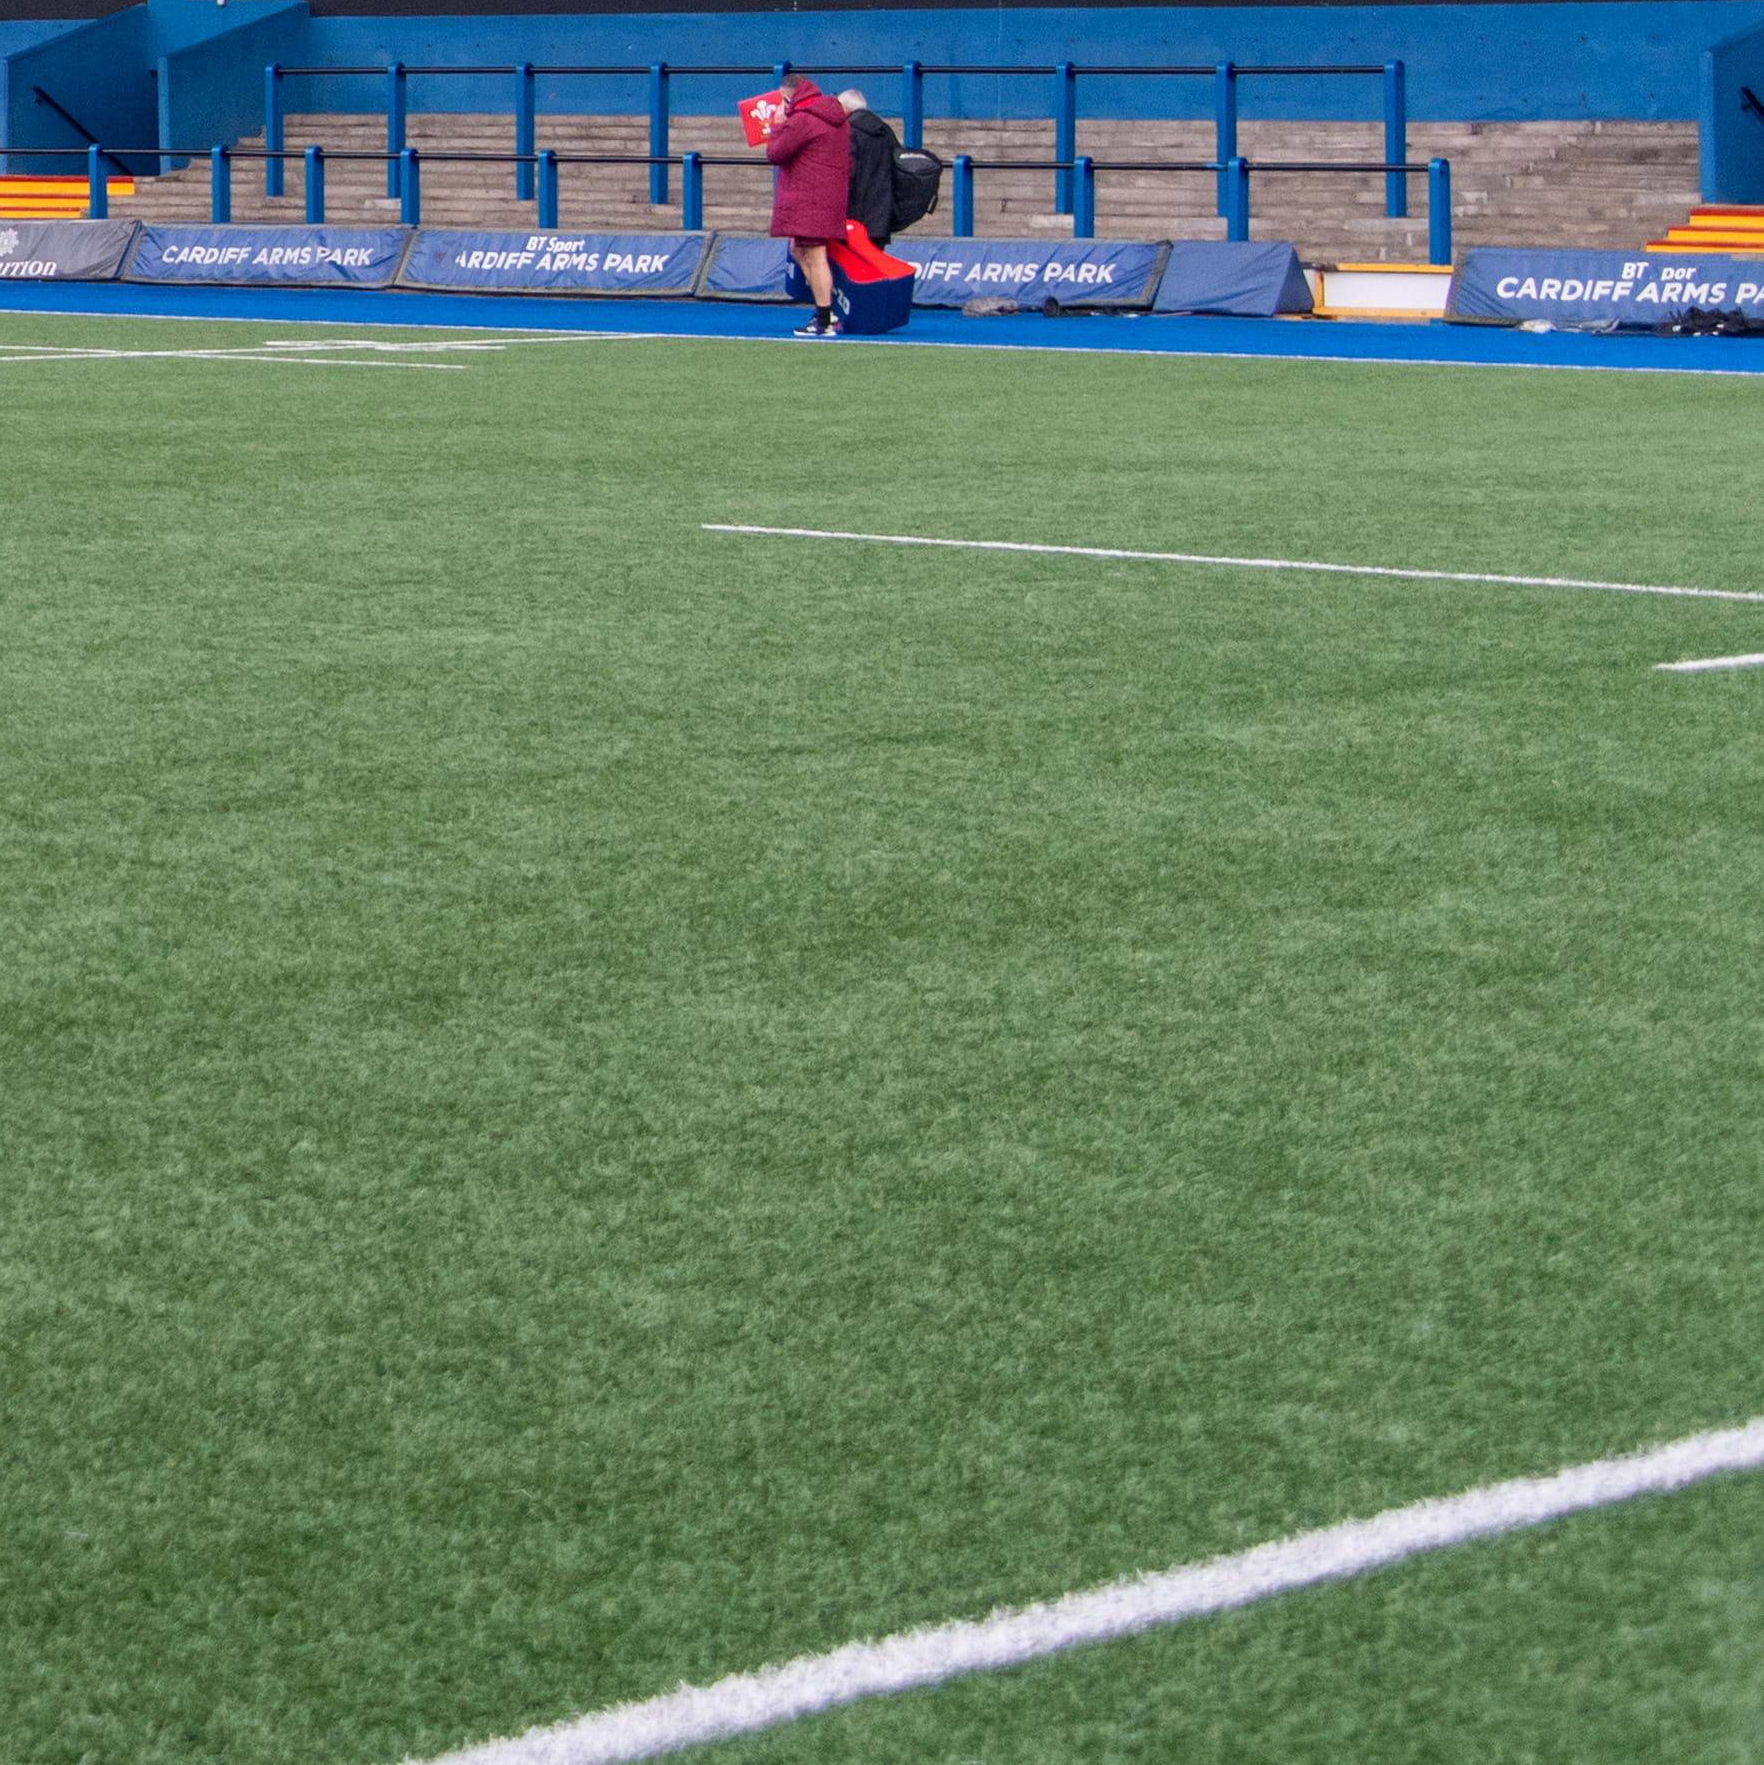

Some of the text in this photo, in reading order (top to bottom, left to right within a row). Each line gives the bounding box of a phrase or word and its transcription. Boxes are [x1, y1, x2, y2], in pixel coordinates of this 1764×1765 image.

[526, 236, 585, 252] BT Sport
[161, 245, 374, 266] CARDIFF ARMS PARK
[535, 253, 600, 272] ARMS
[602, 254, 669, 273] PARK
[965, 262, 1040, 282] ARMS
[1042, 263, 1116, 284] PARK
[1622, 262, 1649, 279] BT
[1496, 277, 1634, 301] CARDIFF
[1636, 282, 1728, 304] ARMS
